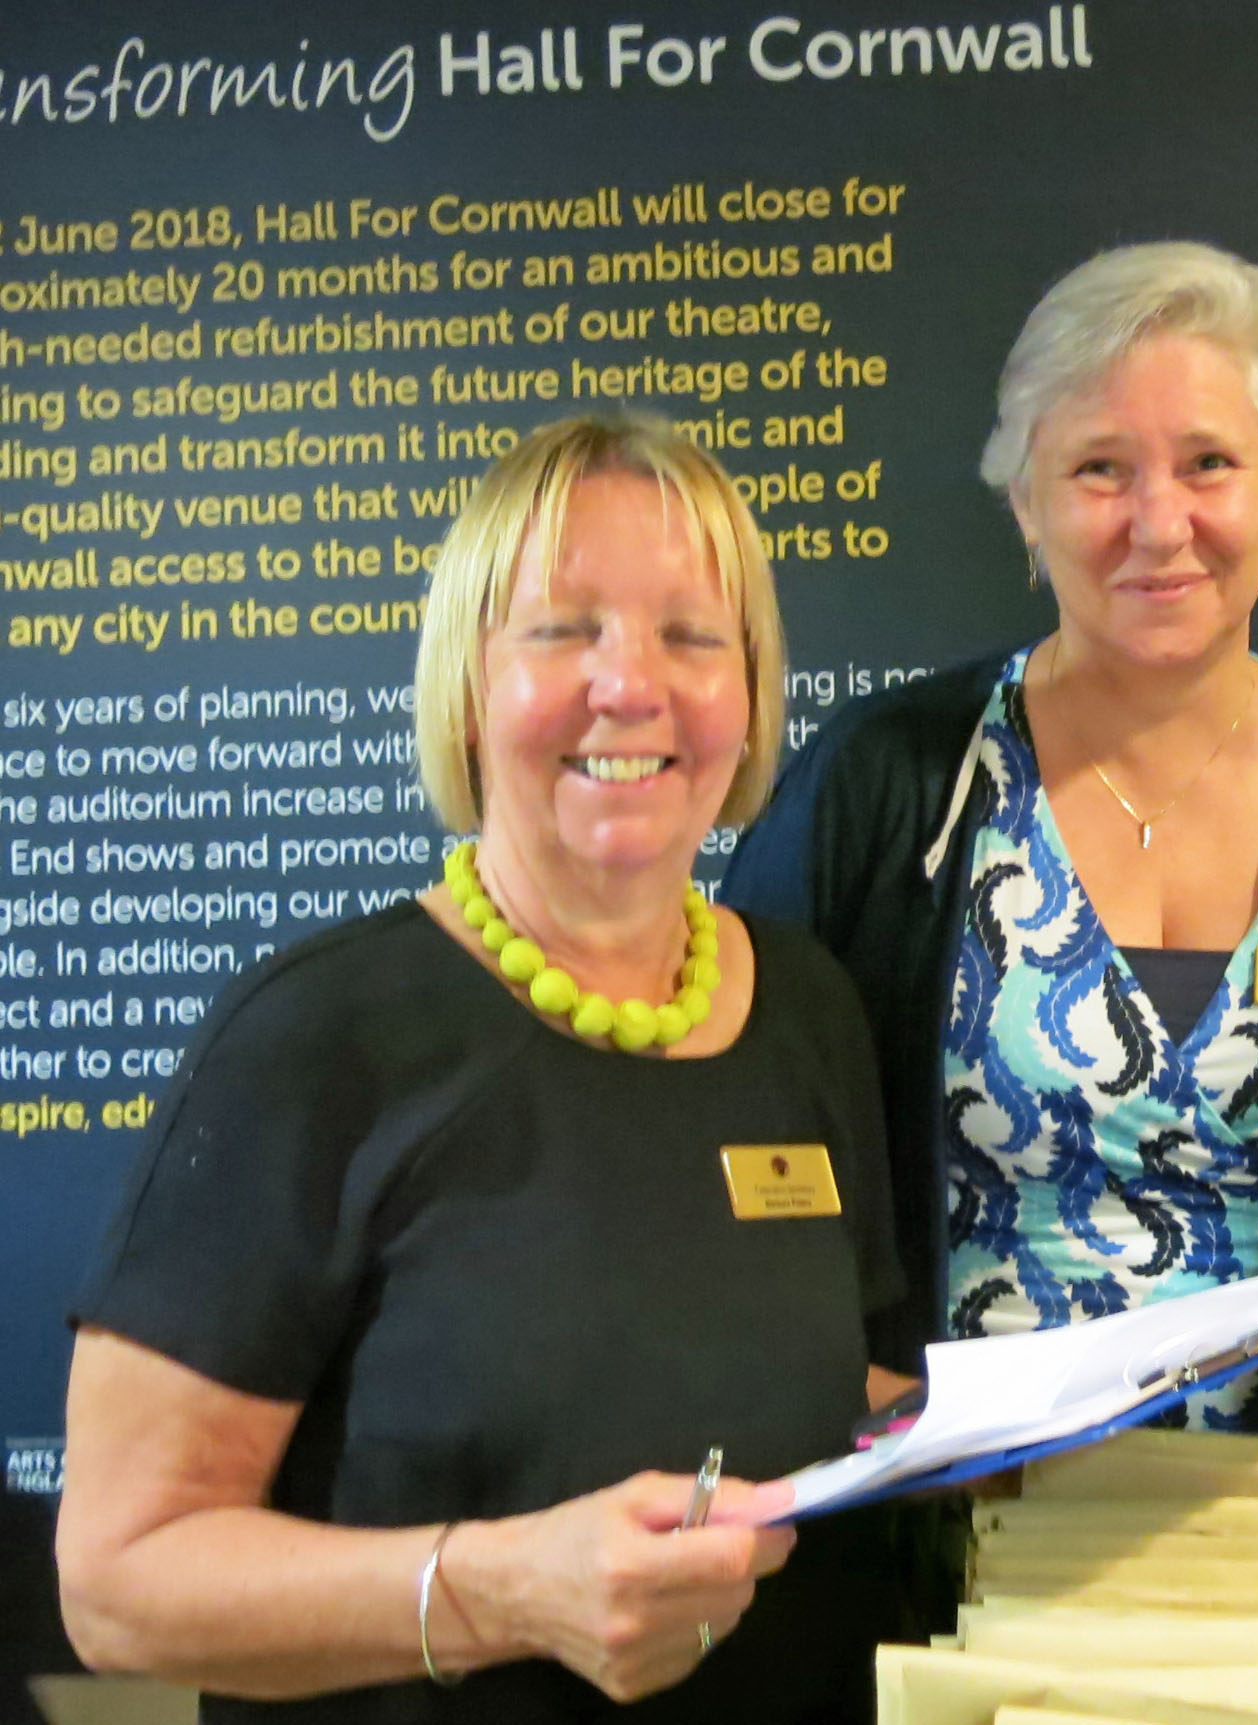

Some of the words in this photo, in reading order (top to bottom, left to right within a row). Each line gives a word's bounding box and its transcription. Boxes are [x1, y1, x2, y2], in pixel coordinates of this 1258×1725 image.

[0, 37, 415, 142] nsforming
[440, 27, 583, 96] Hall
[608, 24, 726, 89] For
[749, 3, 1092, 82] Cornwall
[14, 215, 117, 256] June
[129, 206, 243, 251] 2018,
[256, 202, 338, 243] Hall
[350, 198, 417, 238] For
[429, 187, 622, 235] Cornwall
[633, 183, 707, 225] will
[718, 181, 830, 222] close
[842, 176, 905, 217] for
[0, 266, 201, 313] oximately
[212, 260, 265, 302] 20
[277, 254, 440, 298] months
[449, 250, 511, 290] for
[522, 252, 574, 287] an
[586, 240, 800, 285] ambitious
[811, 233, 893, 276] and
[0, 322, 200, 367] h-needed
[214, 308, 515, 357] refurbishment
[524, 303, 570, 343] of
[579, 306, 655, 343] our
[665, 297, 832, 338] theatre,
[1, 383, 66, 431] ing
[77, 384, 121, 420] to
[132, 371, 338, 424] safeguard
[349, 368, 419, 405] the
[430, 358, 560, 403] future
[571, 357, 750, 402] heritage
[760, 350, 806, 392] of
[816, 348, 888, 387] the
[89, 434, 168, 476] and
[179, 427, 386, 470] transform
[398, 423, 425, 461] it
[436, 421, 518, 459] into
[763, 405, 845, 447] and
[836, 459, 882, 501] of
[175, 493, 302, 527] venue
[314, 483, 398, 521] that
[844, 521, 890, 558] to
[109, 550, 246, 588] access
[257, 543, 301, 581] to
[313, 538, 381, 578] the
[8, 614, 83, 655] any
[94, 603, 170, 652] city
[181, 601, 218, 640] in
[229, 598, 299, 638] the
[848, 661, 873, 696] is
[4, 691, 46, 728] six
[56, 694, 145, 734] years
[154, 685, 191, 722] of
[201, 682, 356, 727] planning,
[56, 744, 91, 777] to
[101, 743, 198, 775] move
[208, 733, 343, 770] forward
[47, 784, 232, 824] auditorium
[243, 782, 385, 817] increase
[396, 778, 425, 812] in
[11, 837, 75, 876] End
[86, 837, 195, 874] shows
[205, 833, 269, 870] and
[281, 831, 430, 875] promote
[90, 886, 278, 930] developing
[289, 887, 350, 920] our
[57, 941, 87, 976] In
[98, 937, 243, 977] addition,
[49, 990, 113, 1028] and
[124, 997, 143, 1026] a
[77, 1044, 112, 1078] to
[0, 1093, 91, 1140] spire,
